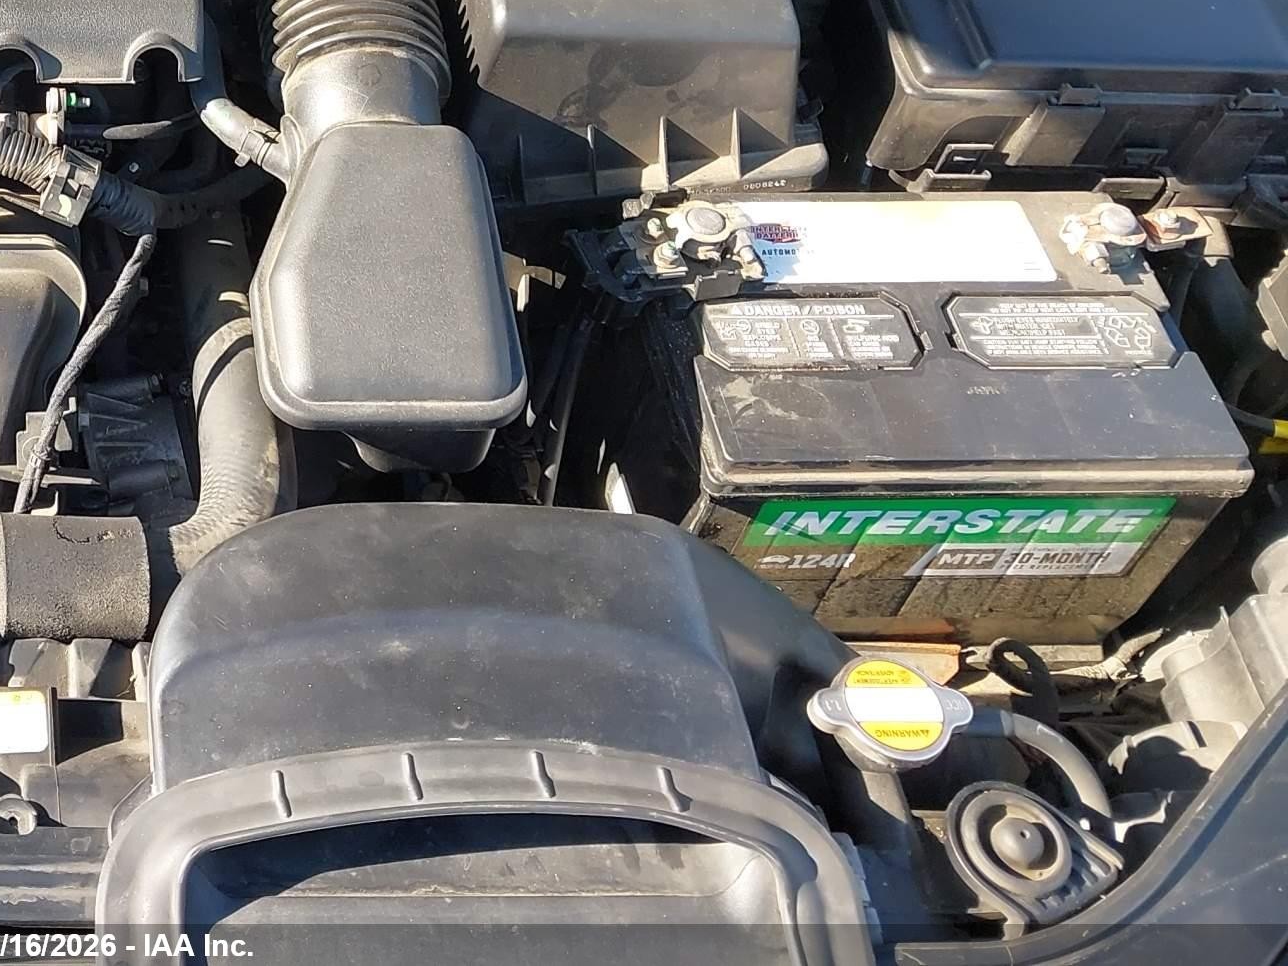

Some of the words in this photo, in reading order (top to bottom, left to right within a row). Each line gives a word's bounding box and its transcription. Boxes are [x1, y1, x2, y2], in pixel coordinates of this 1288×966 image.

[744, 305, 801, 315] DANGER
[815, 304, 866, 314] POISON
[764, 509, 1154, 536] INTERSTATE
[936, 553, 997, 565] MTP
[1003, 551, 1112, 565] 30-MONTH
[875, 729, 922, 738] WARNING
